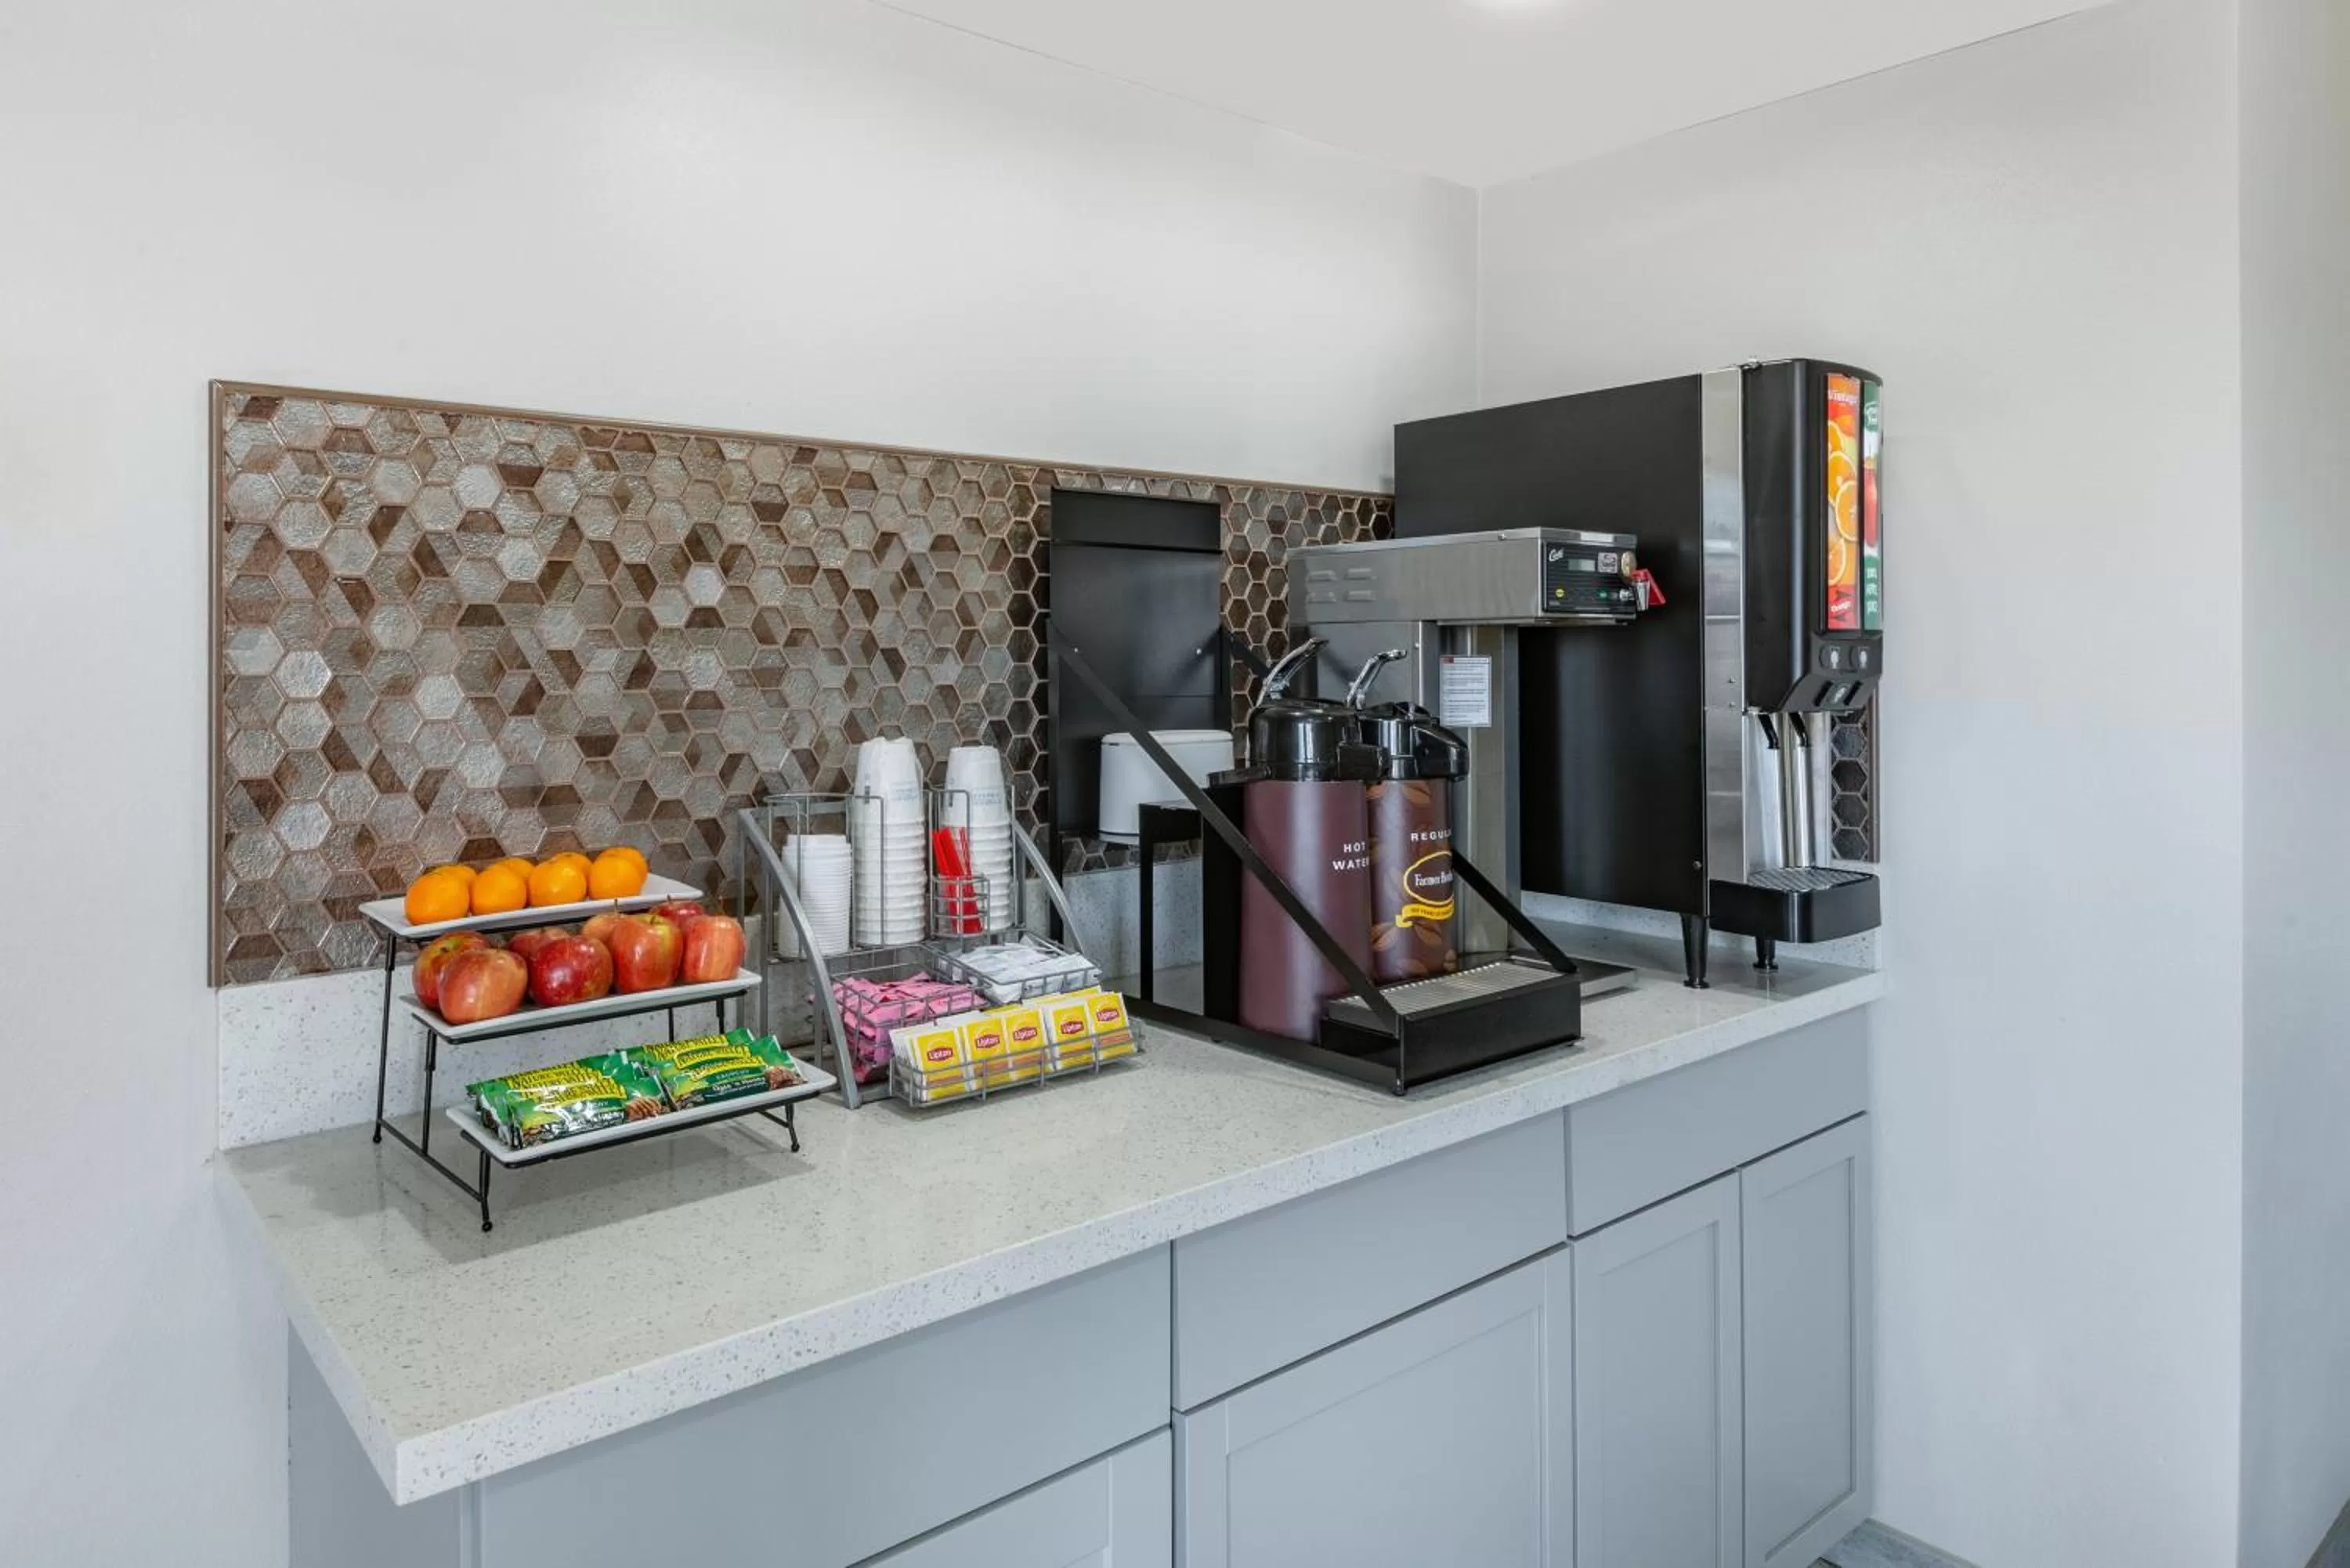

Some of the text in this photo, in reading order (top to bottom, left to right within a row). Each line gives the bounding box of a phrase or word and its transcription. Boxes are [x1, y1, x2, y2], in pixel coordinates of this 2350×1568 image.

[1411, 829, 1452, 842] REGUL
[977, 1037, 999, 1048] Lipton
[928, 1050, 952, 1060] Lipton
